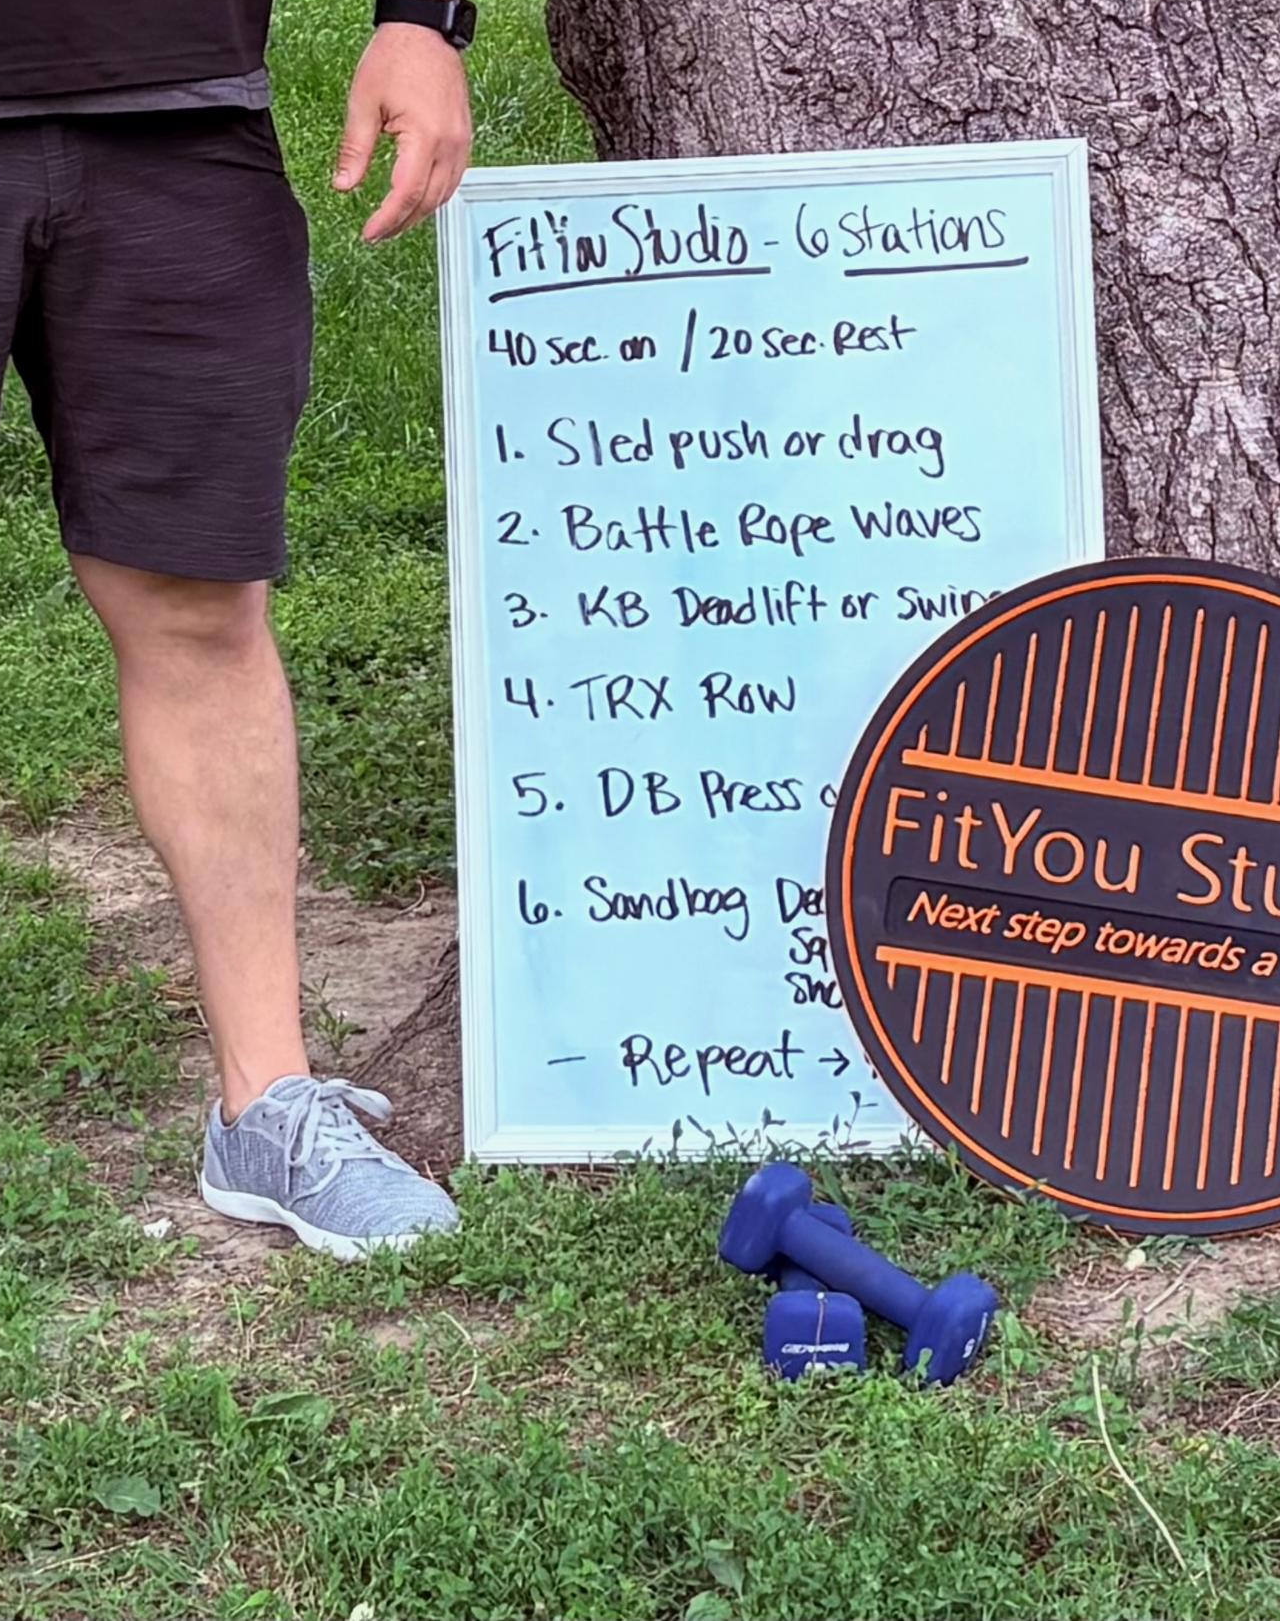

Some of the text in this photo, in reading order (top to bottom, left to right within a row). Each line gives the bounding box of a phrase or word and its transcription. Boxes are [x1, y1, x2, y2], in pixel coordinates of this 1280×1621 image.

[612, 204, 750, 275] Studio
[797, 204, 830, 260] 6
[489, 330, 534, 368] 40
[620, 337, 658, 363] on
[834, 316, 917, 357] Rest
[497, 414, 946, 480] 1. Sled push or drag
[498, 512, 540, 546] 2.
[562, 505, 720, 554] Battle
[739, 504, 836, 558] Rope
[505, 581, 1002, 629] 3. KB Deadlift or Swin
[505, 678, 555, 720] 4.
[571, 675, 674, 722] TRX
[513, 773, 565, 818] 5.
[599, 768, 682, 819] DB
[700, 771, 803, 820] Press
[882, 786, 1142, 894] FitYou
[519, 880, 563, 926] 6.
[584, 877, 751, 942] Sandbag
[906, 890, 1002, 935] Next
[1003, 910, 1086, 955] step
[1094, 921, 1246, 972] towards
[1251, 951, 1280, 978] a
[621, 1030, 805, 1097] Repeat
